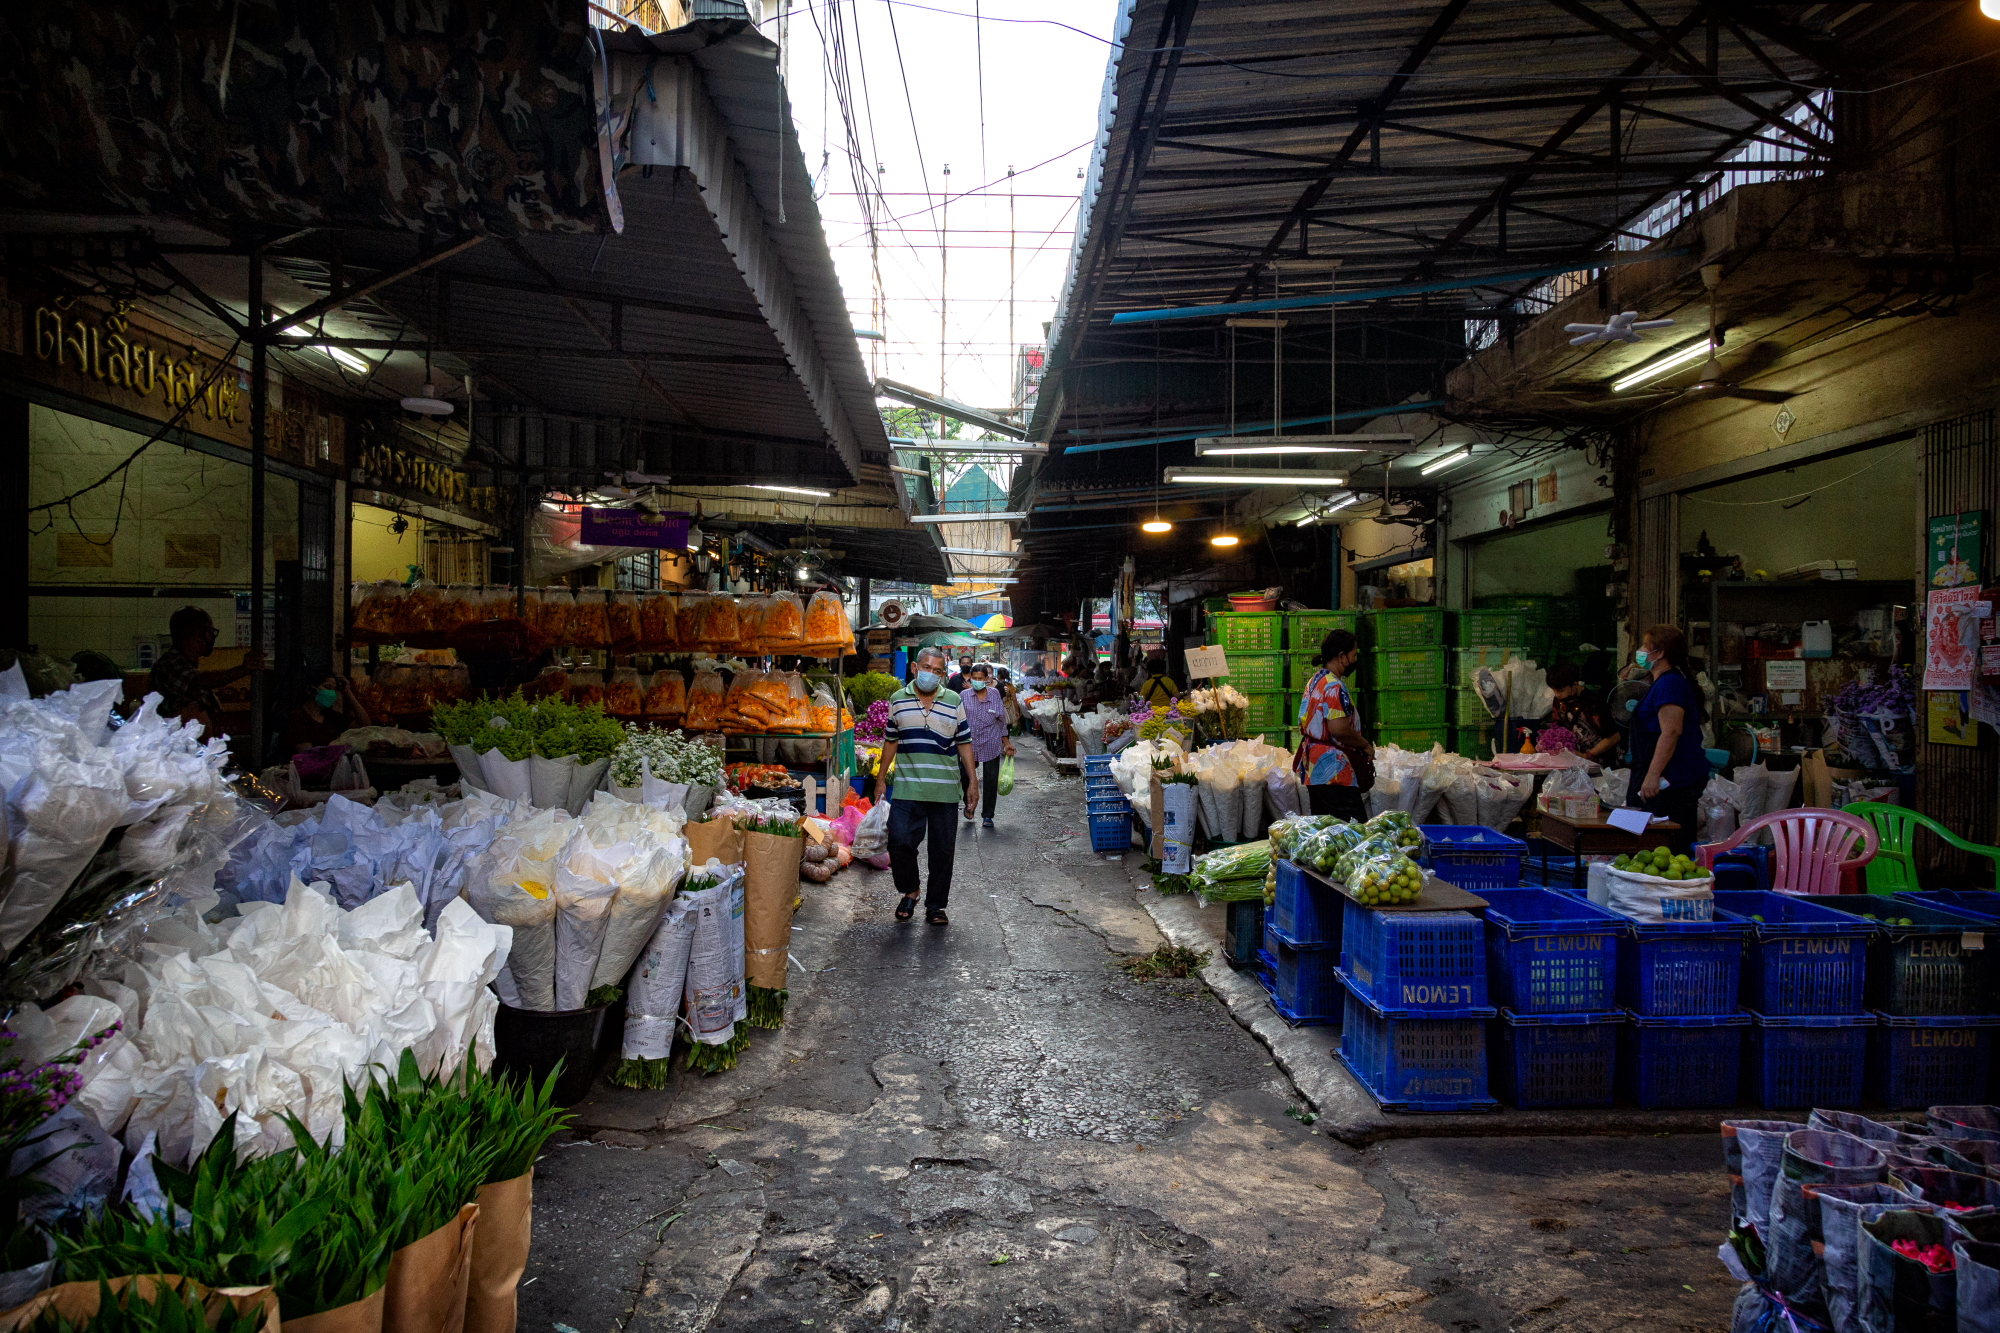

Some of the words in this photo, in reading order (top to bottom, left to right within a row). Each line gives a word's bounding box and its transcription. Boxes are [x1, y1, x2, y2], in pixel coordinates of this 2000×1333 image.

[1452, 851, 1506, 867] LEMON
[1534, 936, 1602, 952] LEMON
[1782, 938, 1851, 955] LEMON
[1402, 984, 1472, 1004] LEMON
[1911, 1029, 1977, 1048] LEMON
